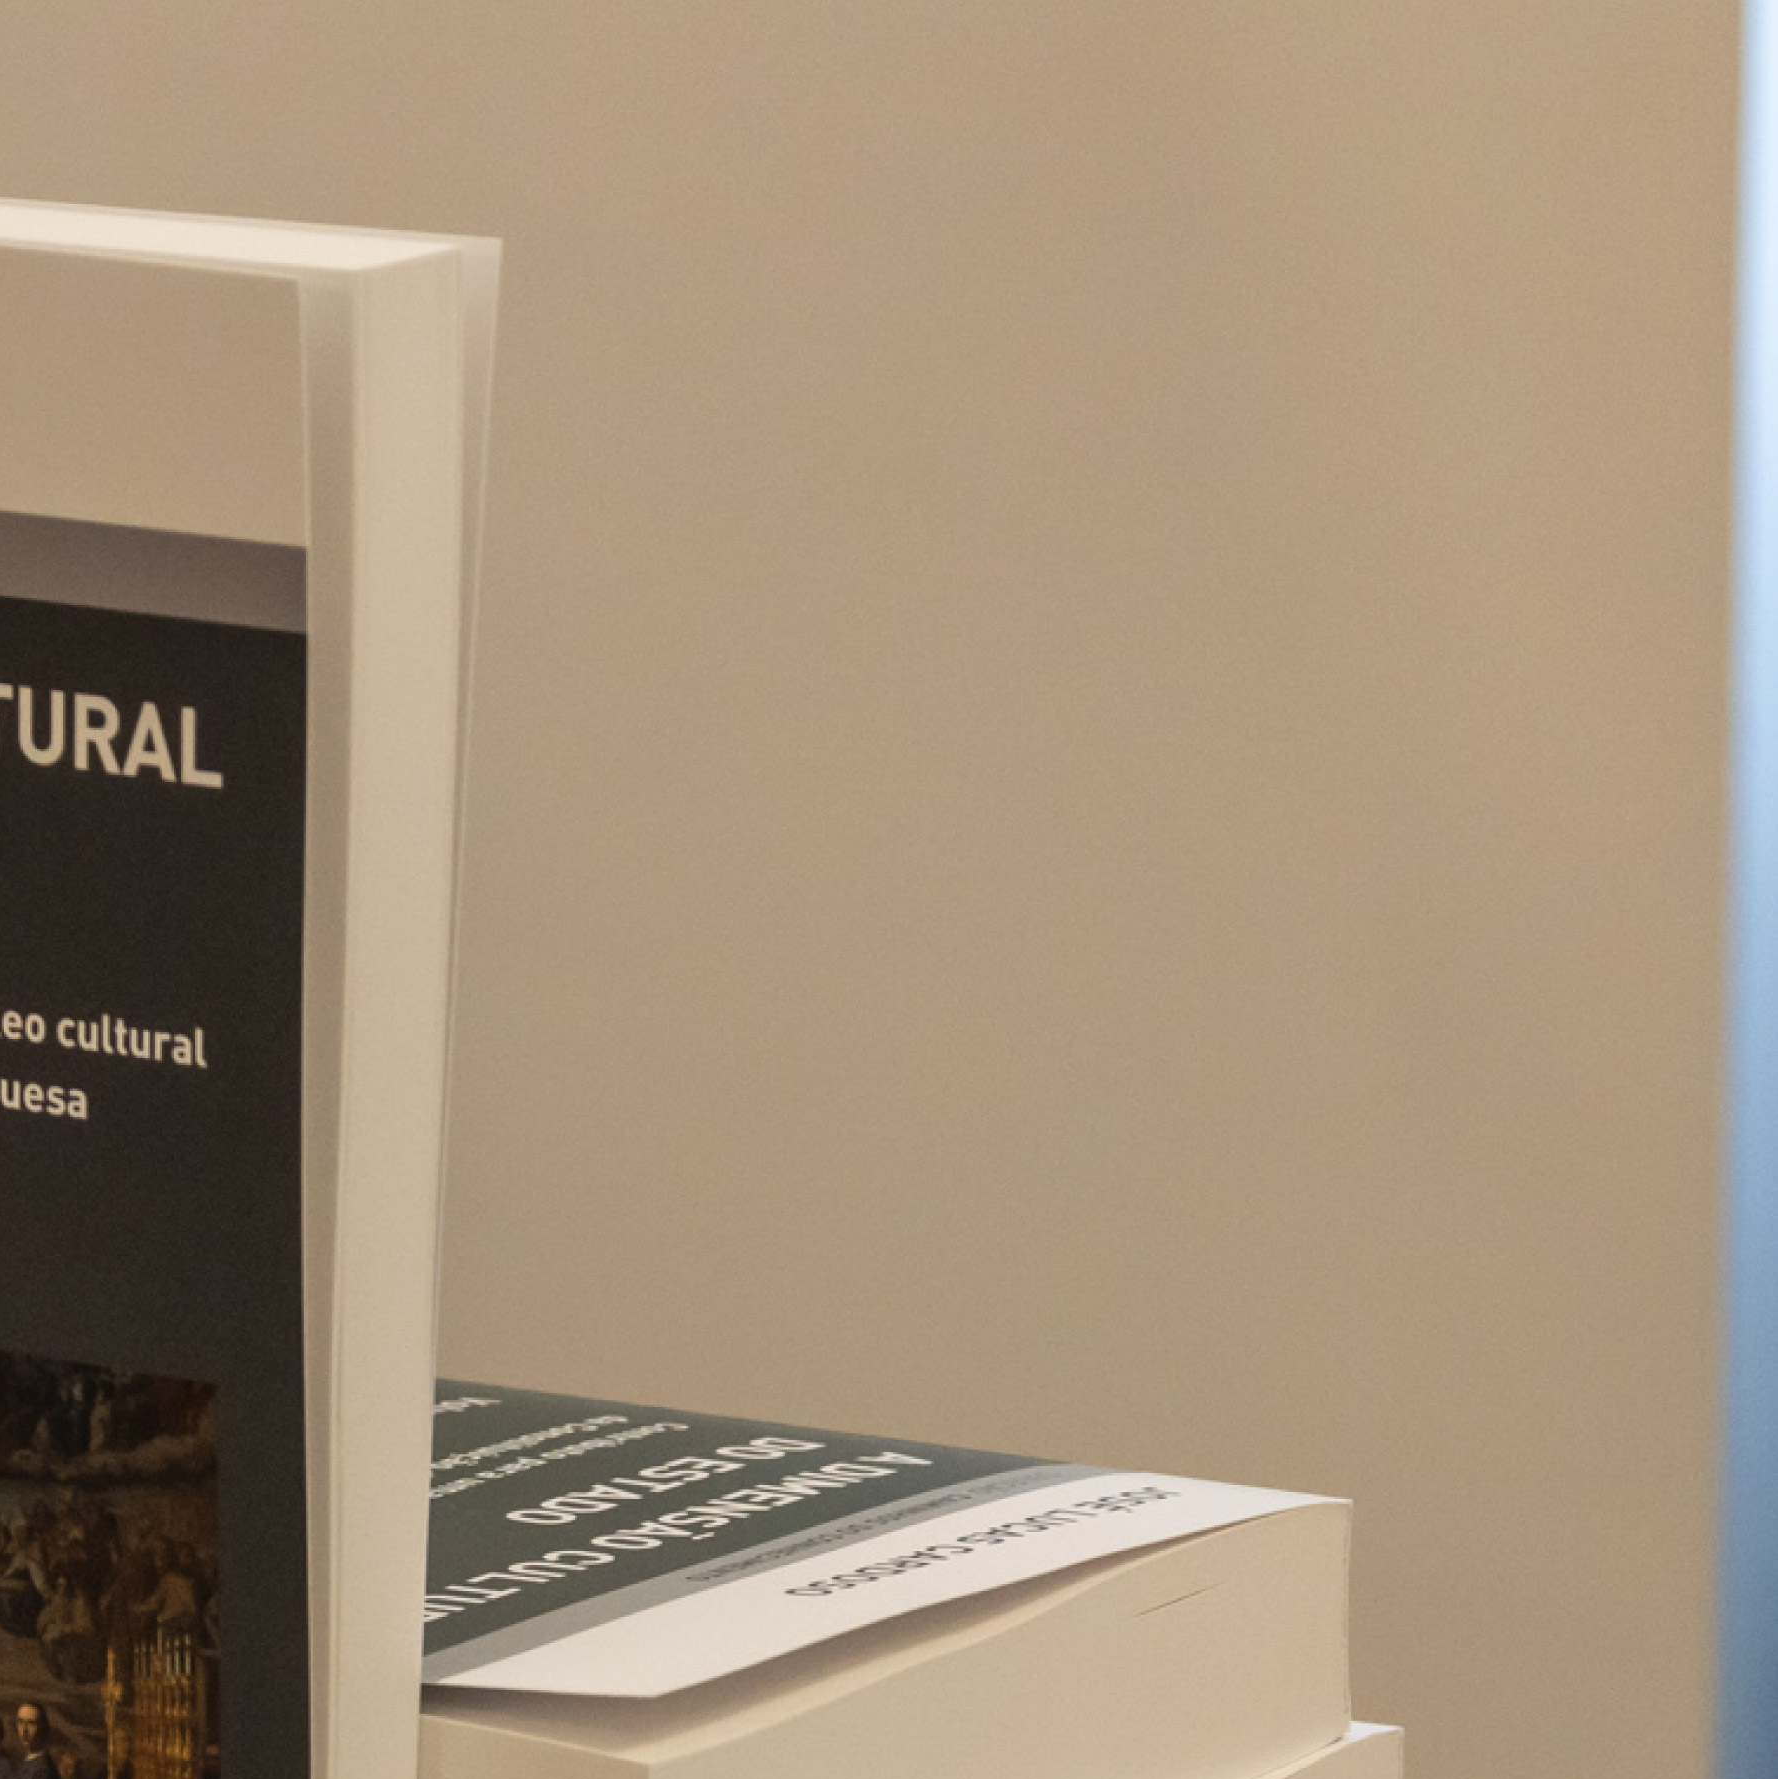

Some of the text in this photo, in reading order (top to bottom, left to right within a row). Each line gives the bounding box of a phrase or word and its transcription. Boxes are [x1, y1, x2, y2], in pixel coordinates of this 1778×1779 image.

[57, 1010, 207, 1068] cultural
[716, 1437, 824, 1460] DO
[871, 1451, 933, 1467] A
[506, 1457, 745, 1525] ESTADO
[591, 1461, 897, 1550] DIMENSÃO
[424, 1550, 616, 1623] CULTU
